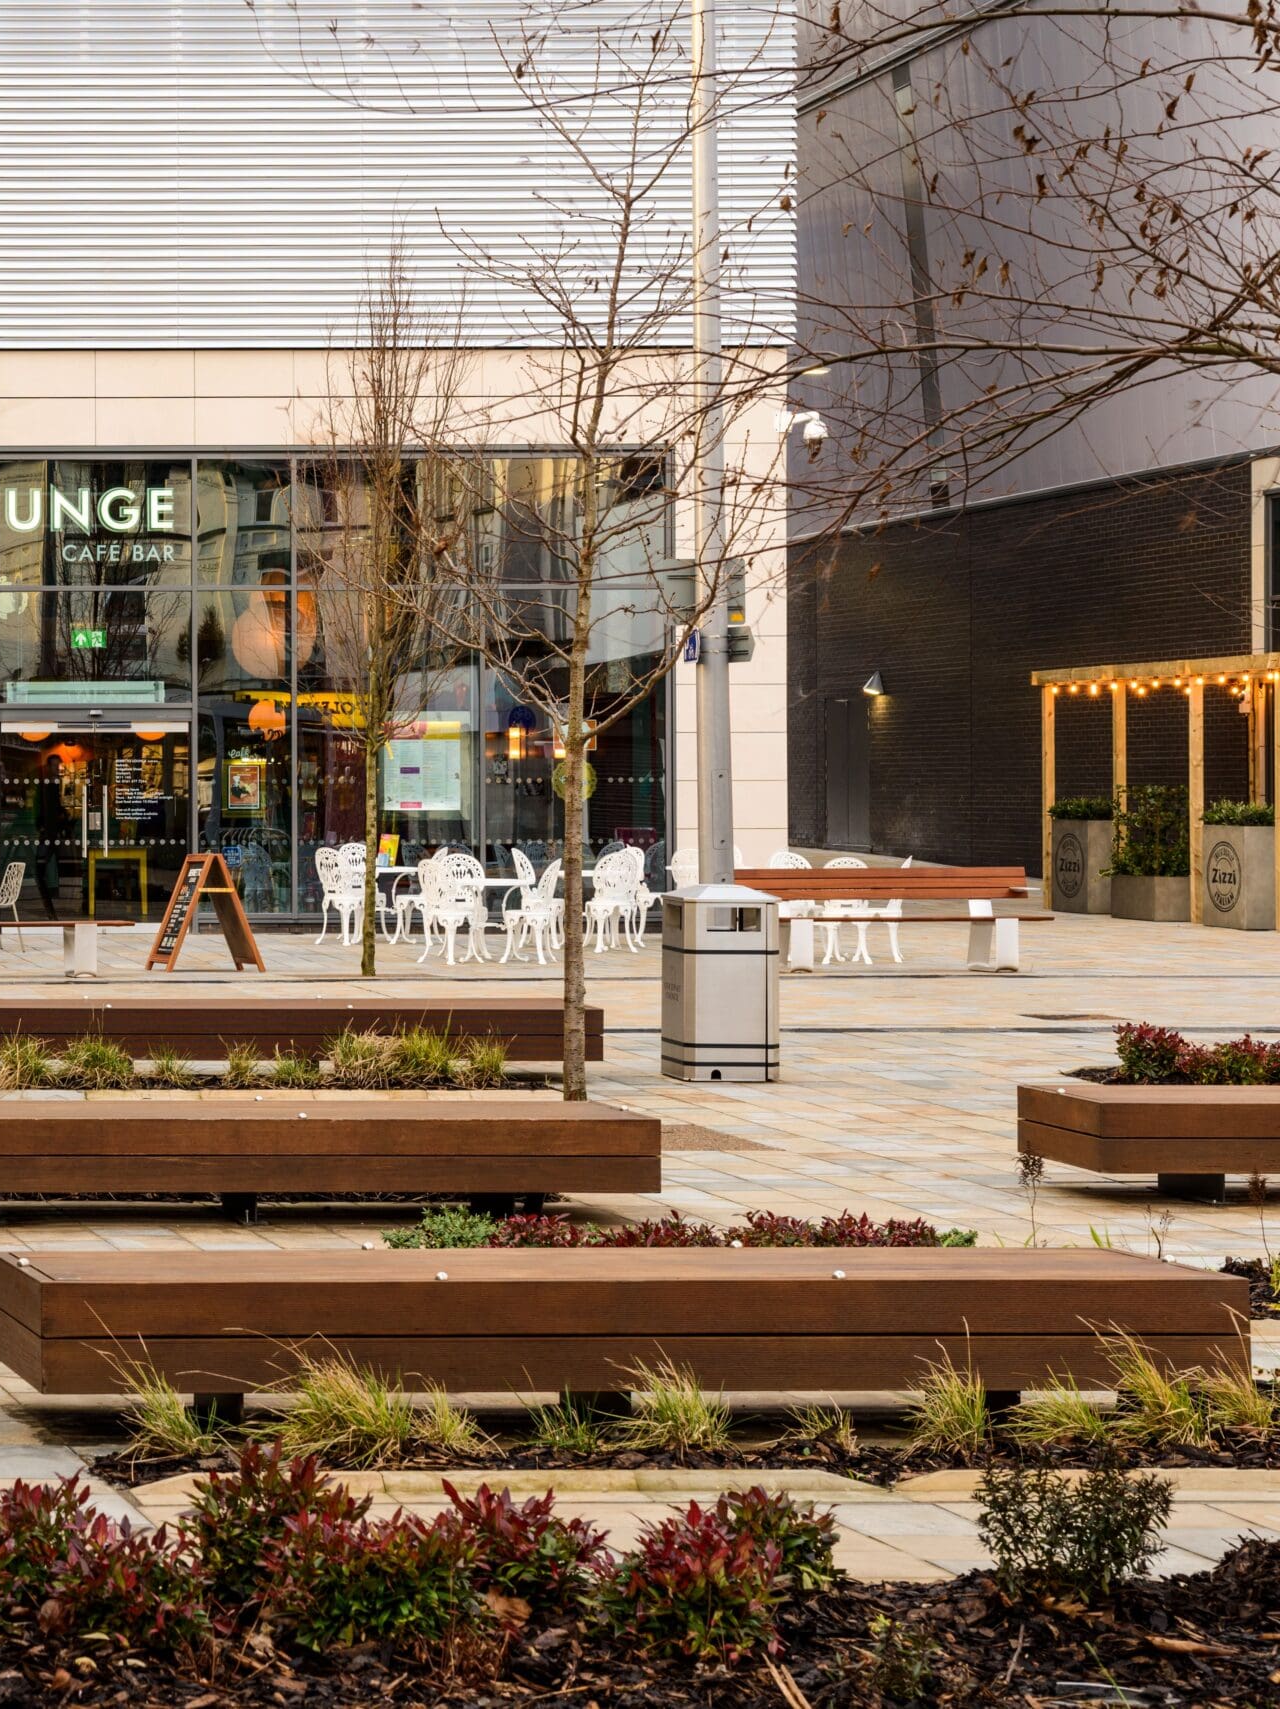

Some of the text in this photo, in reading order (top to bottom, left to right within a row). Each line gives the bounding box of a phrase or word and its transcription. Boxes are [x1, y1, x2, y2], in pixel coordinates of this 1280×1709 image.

[62, 541, 174, 562] CAFÉ BAR
[1060, 858, 1080, 873] Zizzi
[1212, 867, 1237, 885] Zizzi
